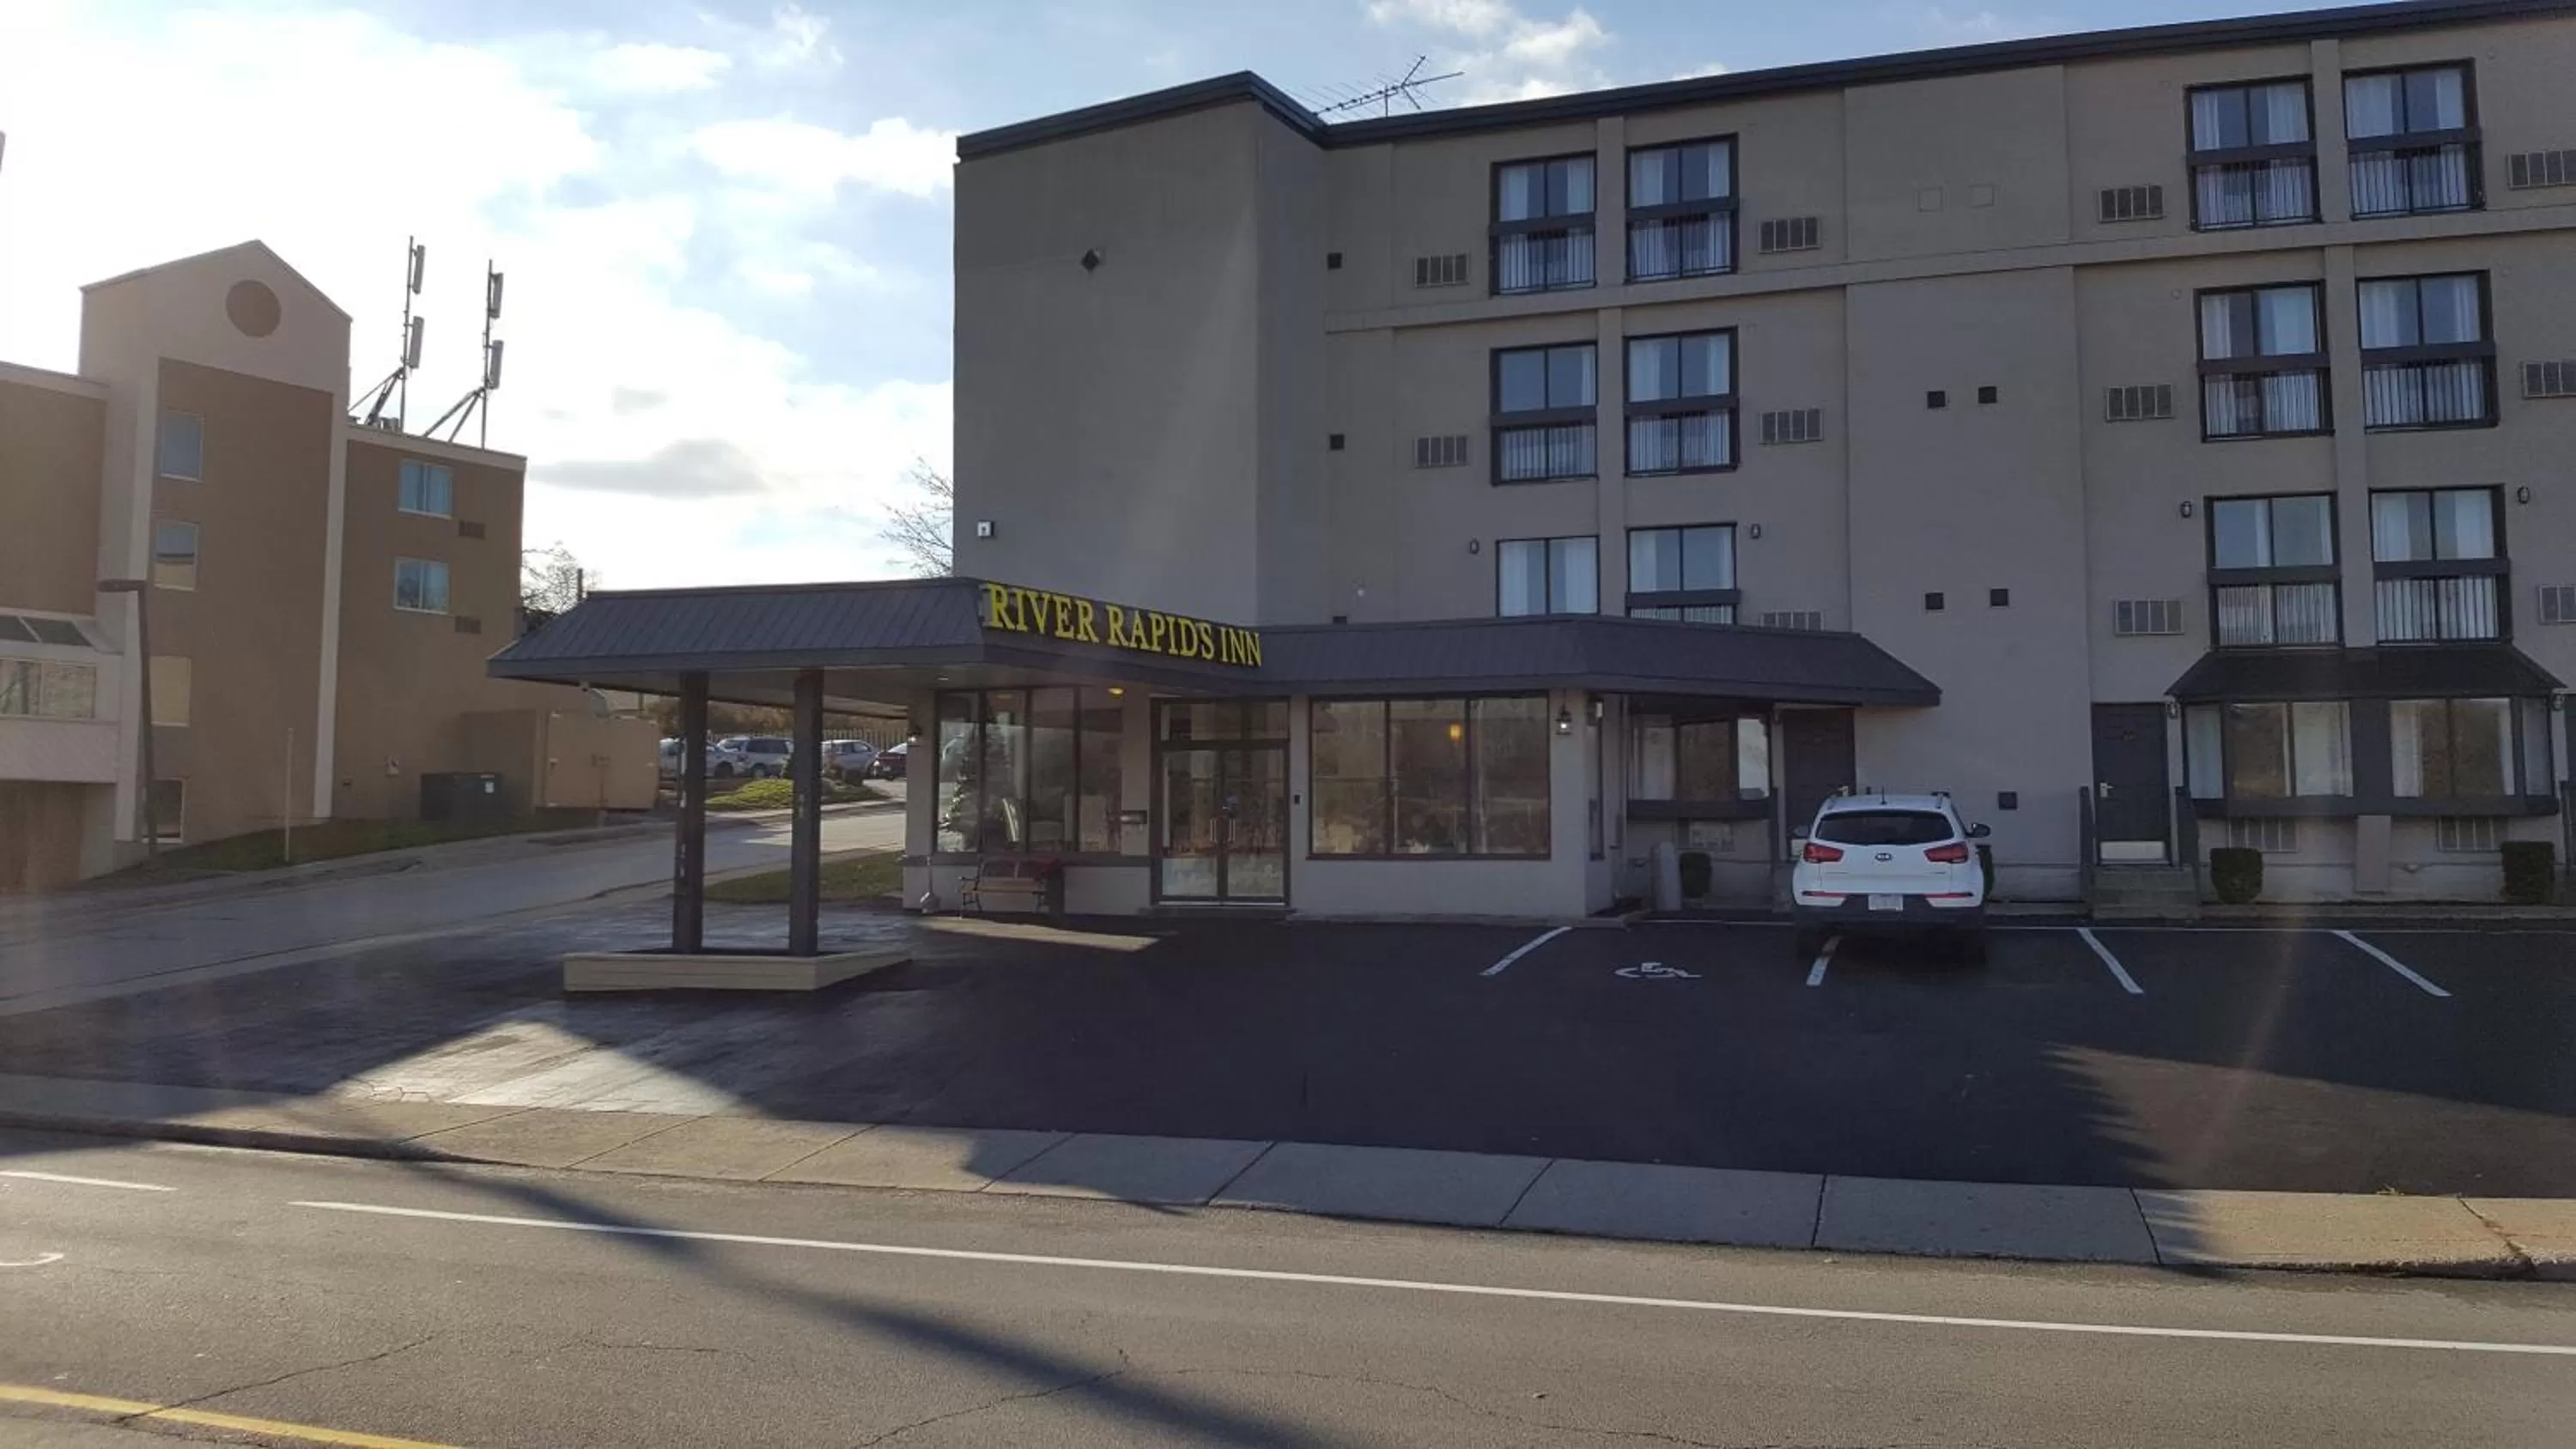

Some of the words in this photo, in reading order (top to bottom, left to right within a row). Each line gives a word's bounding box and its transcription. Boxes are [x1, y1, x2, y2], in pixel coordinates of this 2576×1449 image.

[982, 583, 1099, 643] RIVER
[1106, 604, 1215, 660] RAPIDS
[1219, 627, 1262, 667] INN
